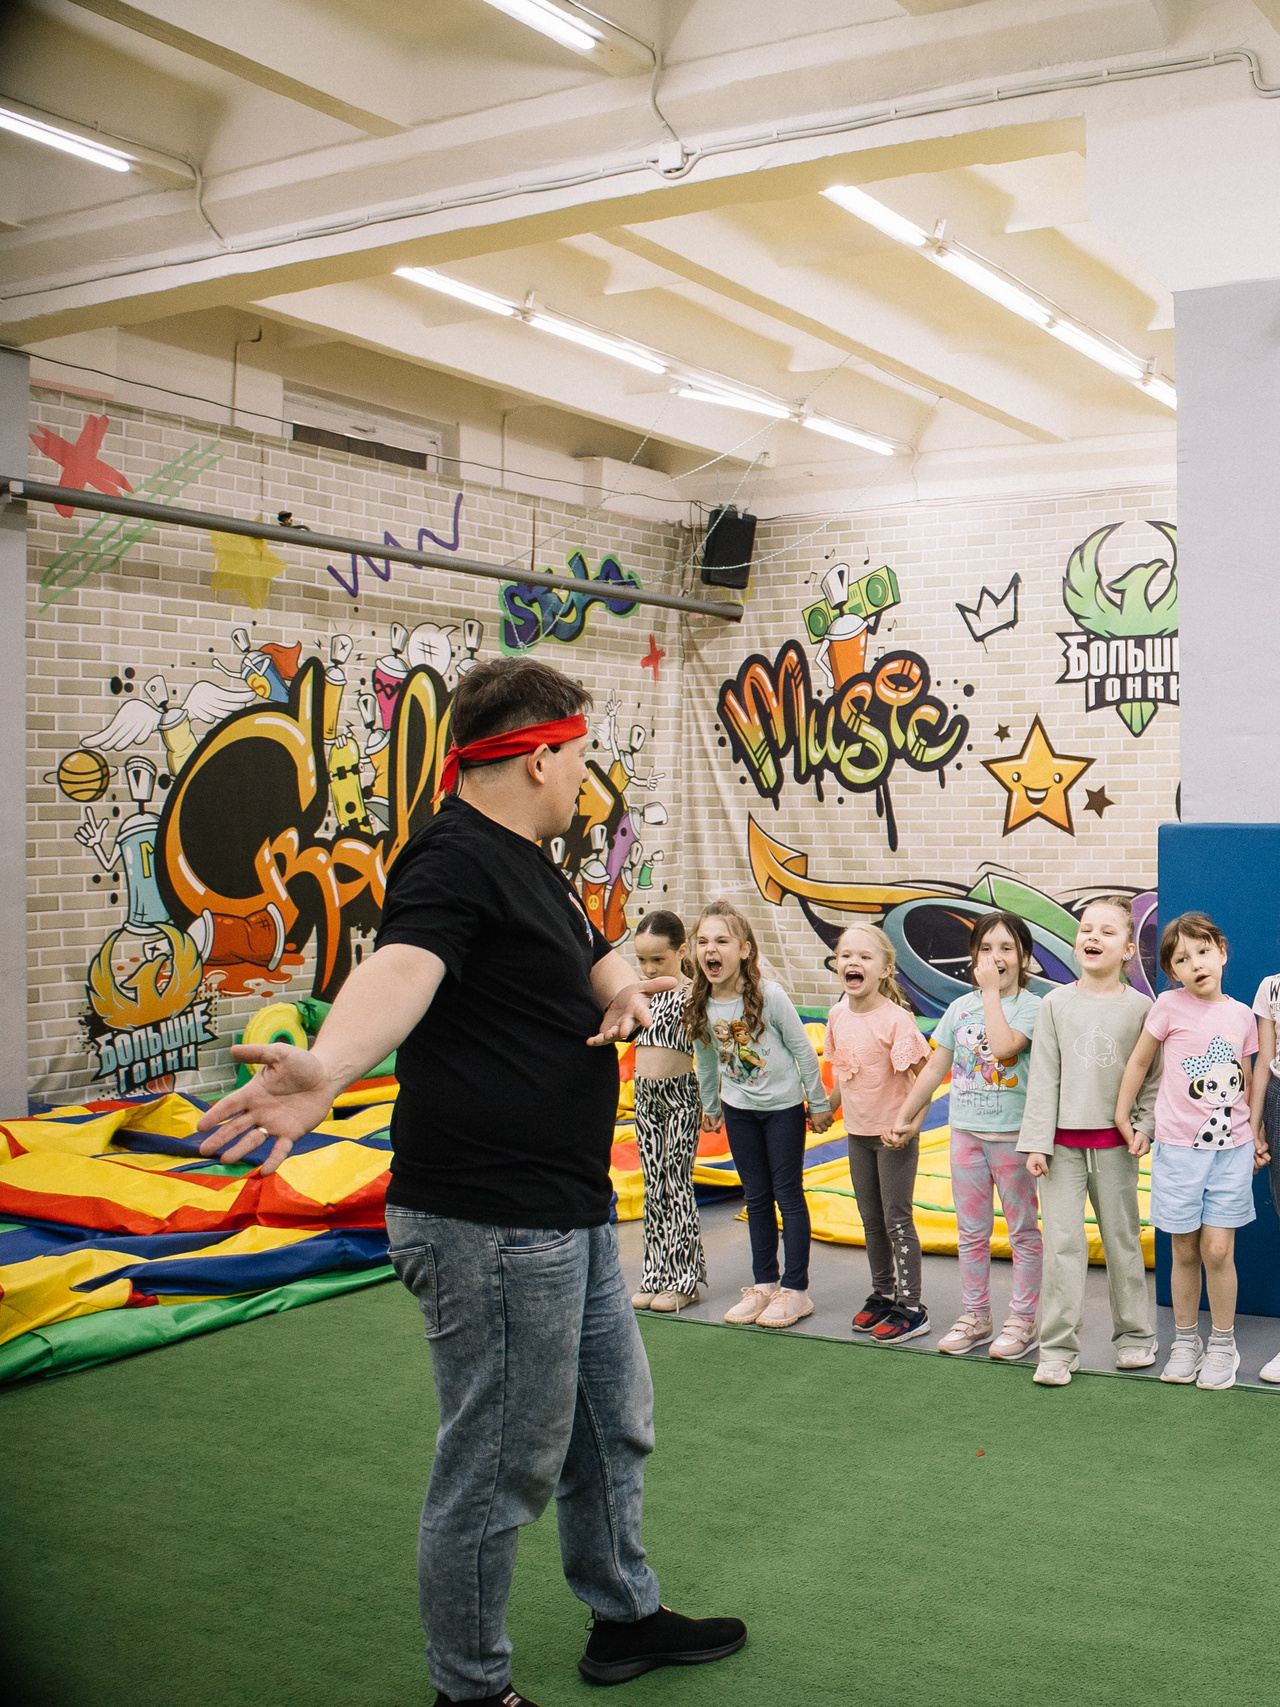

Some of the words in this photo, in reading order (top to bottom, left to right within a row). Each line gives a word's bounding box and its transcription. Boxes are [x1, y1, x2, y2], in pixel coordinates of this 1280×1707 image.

[1063, 634, 1179, 681] БОЛЬШ
[94, 1001, 214, 1077] БОЛЬШИЕ
[117, 1044, 198, 1094] ГОНКИ
